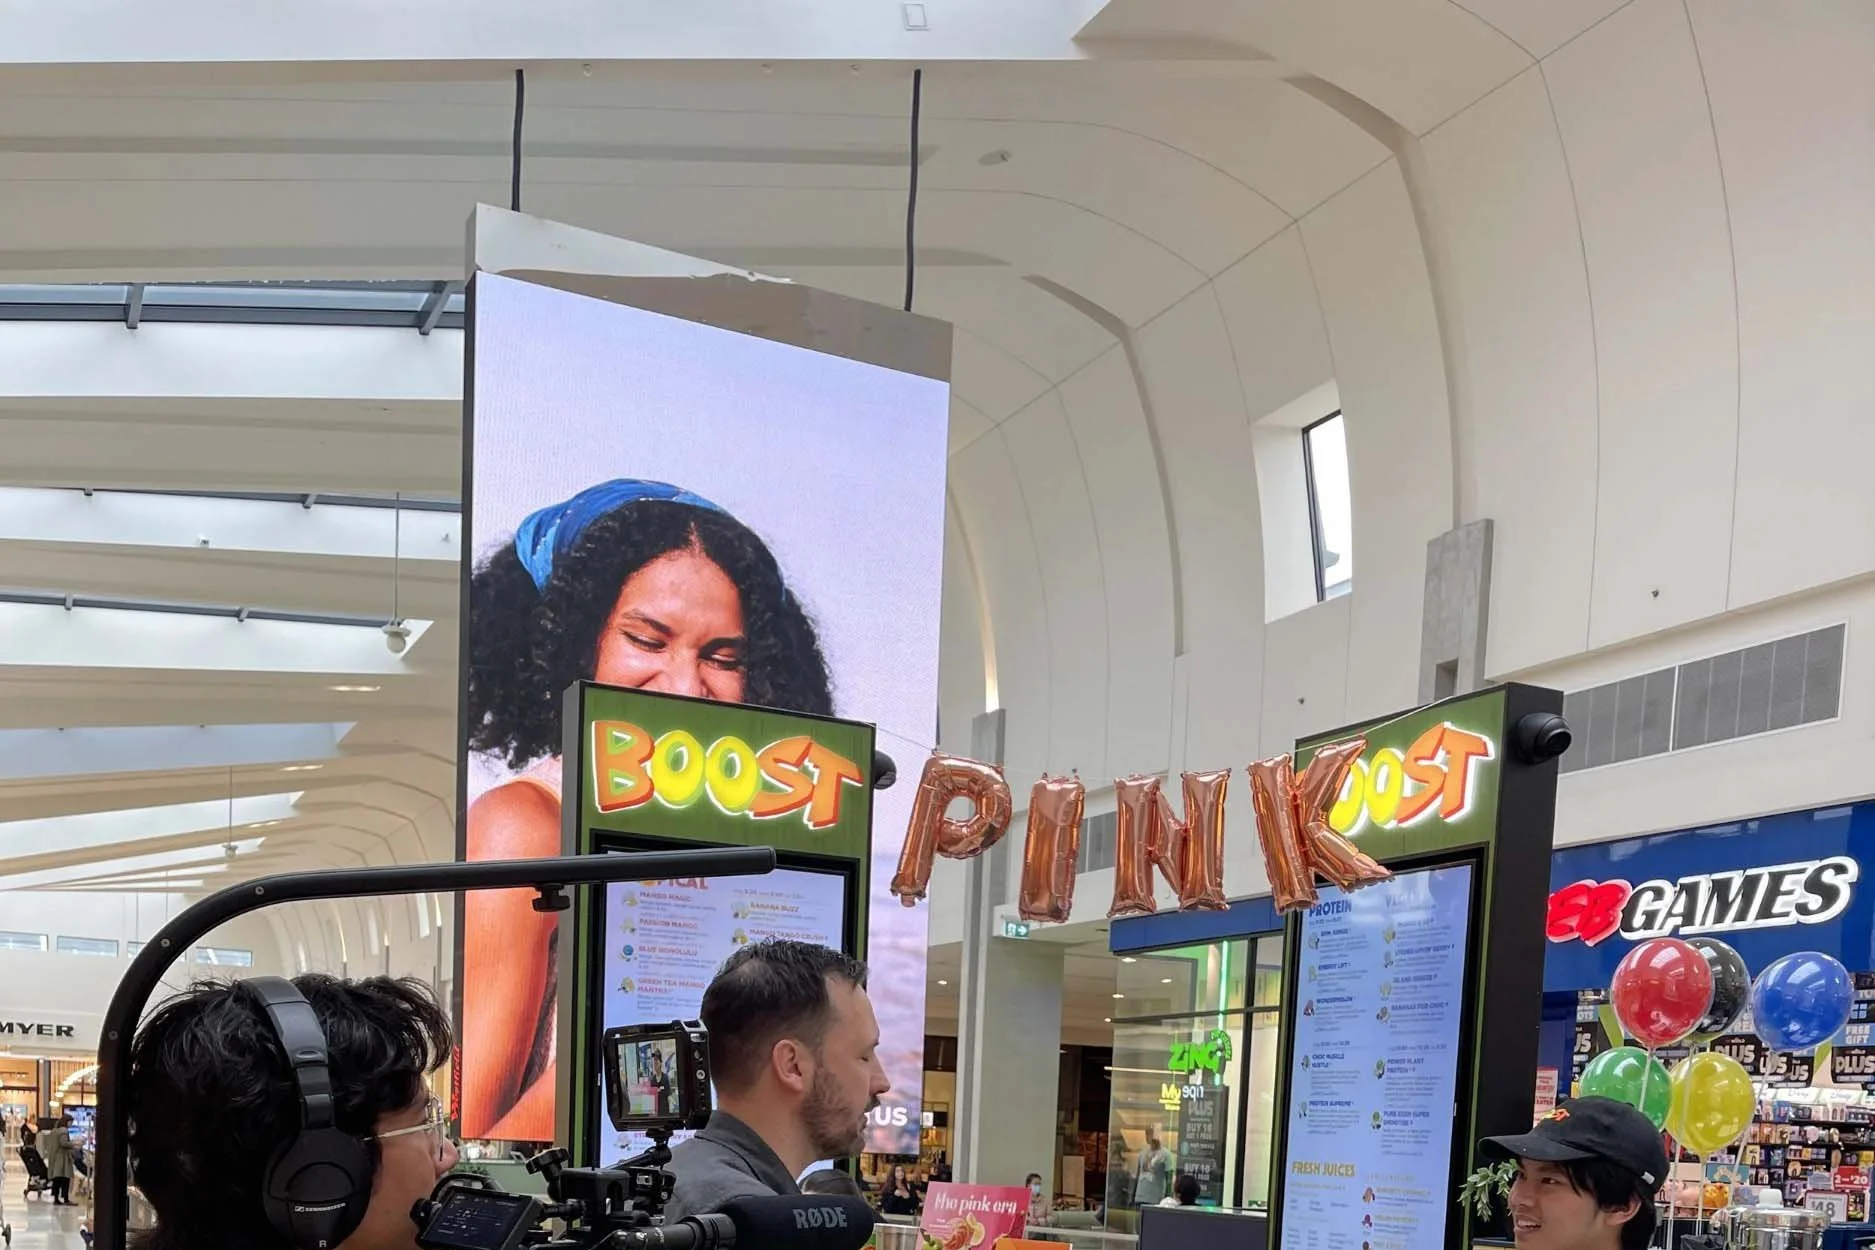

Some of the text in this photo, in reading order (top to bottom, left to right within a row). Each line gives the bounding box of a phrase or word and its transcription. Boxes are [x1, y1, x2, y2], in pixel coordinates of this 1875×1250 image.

[592, 719, 865, 830] BOOST
[1328, 721, 1495, 836] OOST
[890, 736, 1394, 922] PINK
[1619, 856, 1859, 939] GAMES
[0, 1021, 74, 1038] MYER
[1291, 1160, 1356, 1177] FRESH JUICES
[958, 1194, 991, 1215] pink
[792, 1206, 848, 1230] RØDE
[319, 1239, 327, 1248] R
